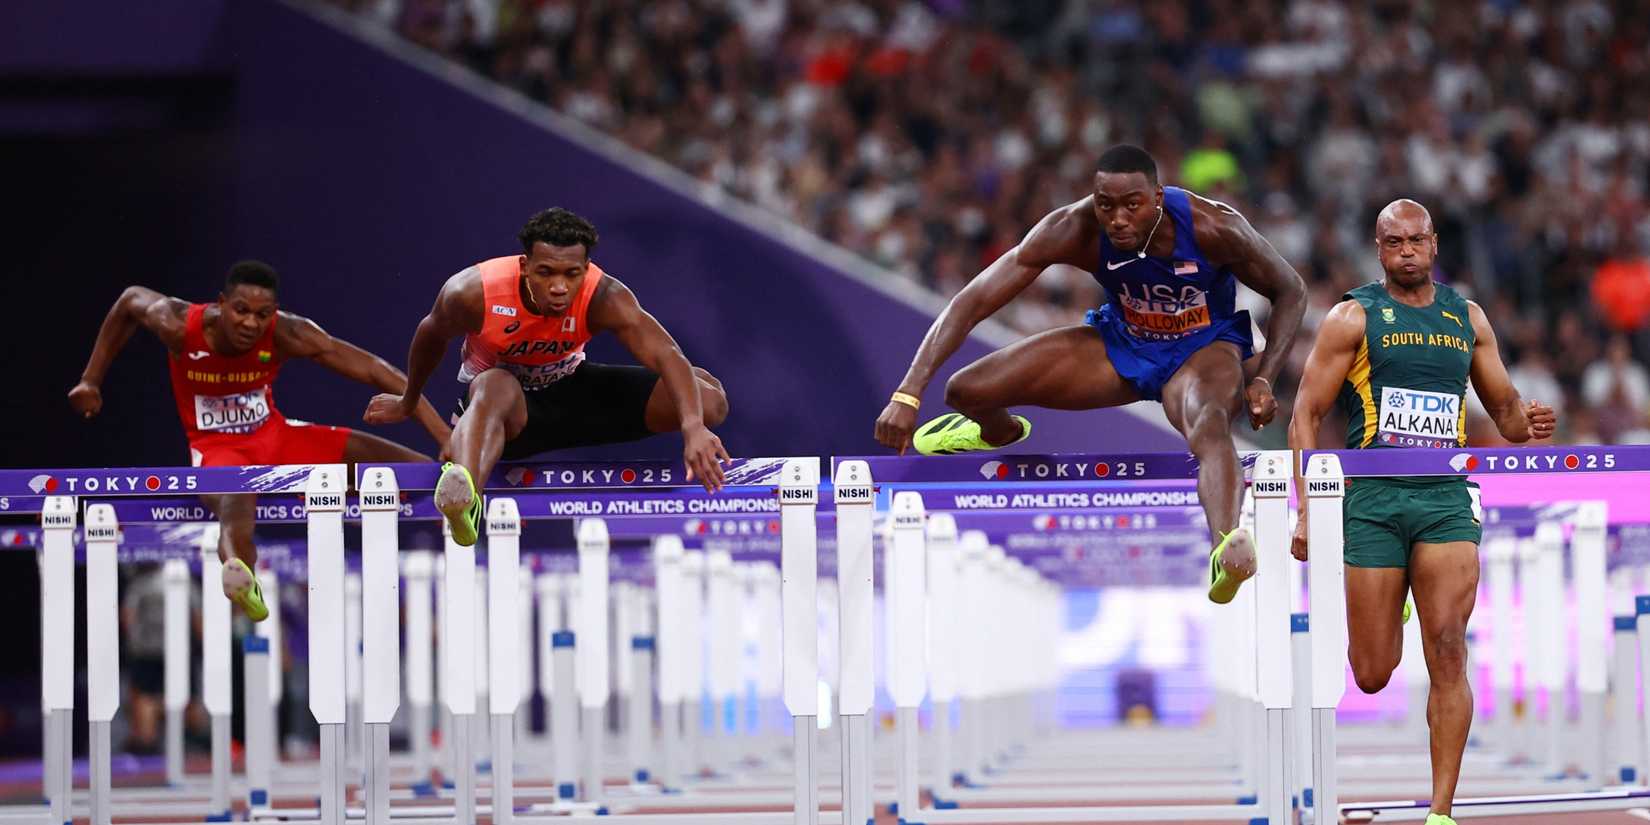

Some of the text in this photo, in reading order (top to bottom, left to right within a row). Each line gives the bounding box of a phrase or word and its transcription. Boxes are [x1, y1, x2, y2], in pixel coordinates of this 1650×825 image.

[1118, 283, 1204, 304] USA
[1126, 309, 1204, 331] HOLLOWAY
[496, 341, 575, 356] JAPAN
[1382, 333, 1469, 353] SOUTH AFRICA
[1406, 393, 1454, 414] TDK
[202, 402, 264, 426] DJUMO
[1384, 412, 1454, 436] ALKANA
[1256, 482, 1287, 492] NISHI
[1309, 481, 1340, 491] NISHI
[782, 489, 813, 499] NISHI
[839, 488, 869, 498] NISHI
[309, 496, 341, 506] NISHI
[363, 495, 395, 505] NISHI
[550, 498, 779, 514] WORLD ATHLETICS CHAMPIONS
[955, 495, 1008, 508] WORLD
[1011, 493, 1089, 507] ATHLETICS
[45, 515, 71, 525] NISHI
[151, 507, 204, 520] WORLD
[88, 528, 114, 538] NISHI
[490, 523, 516, 531] NISHI
